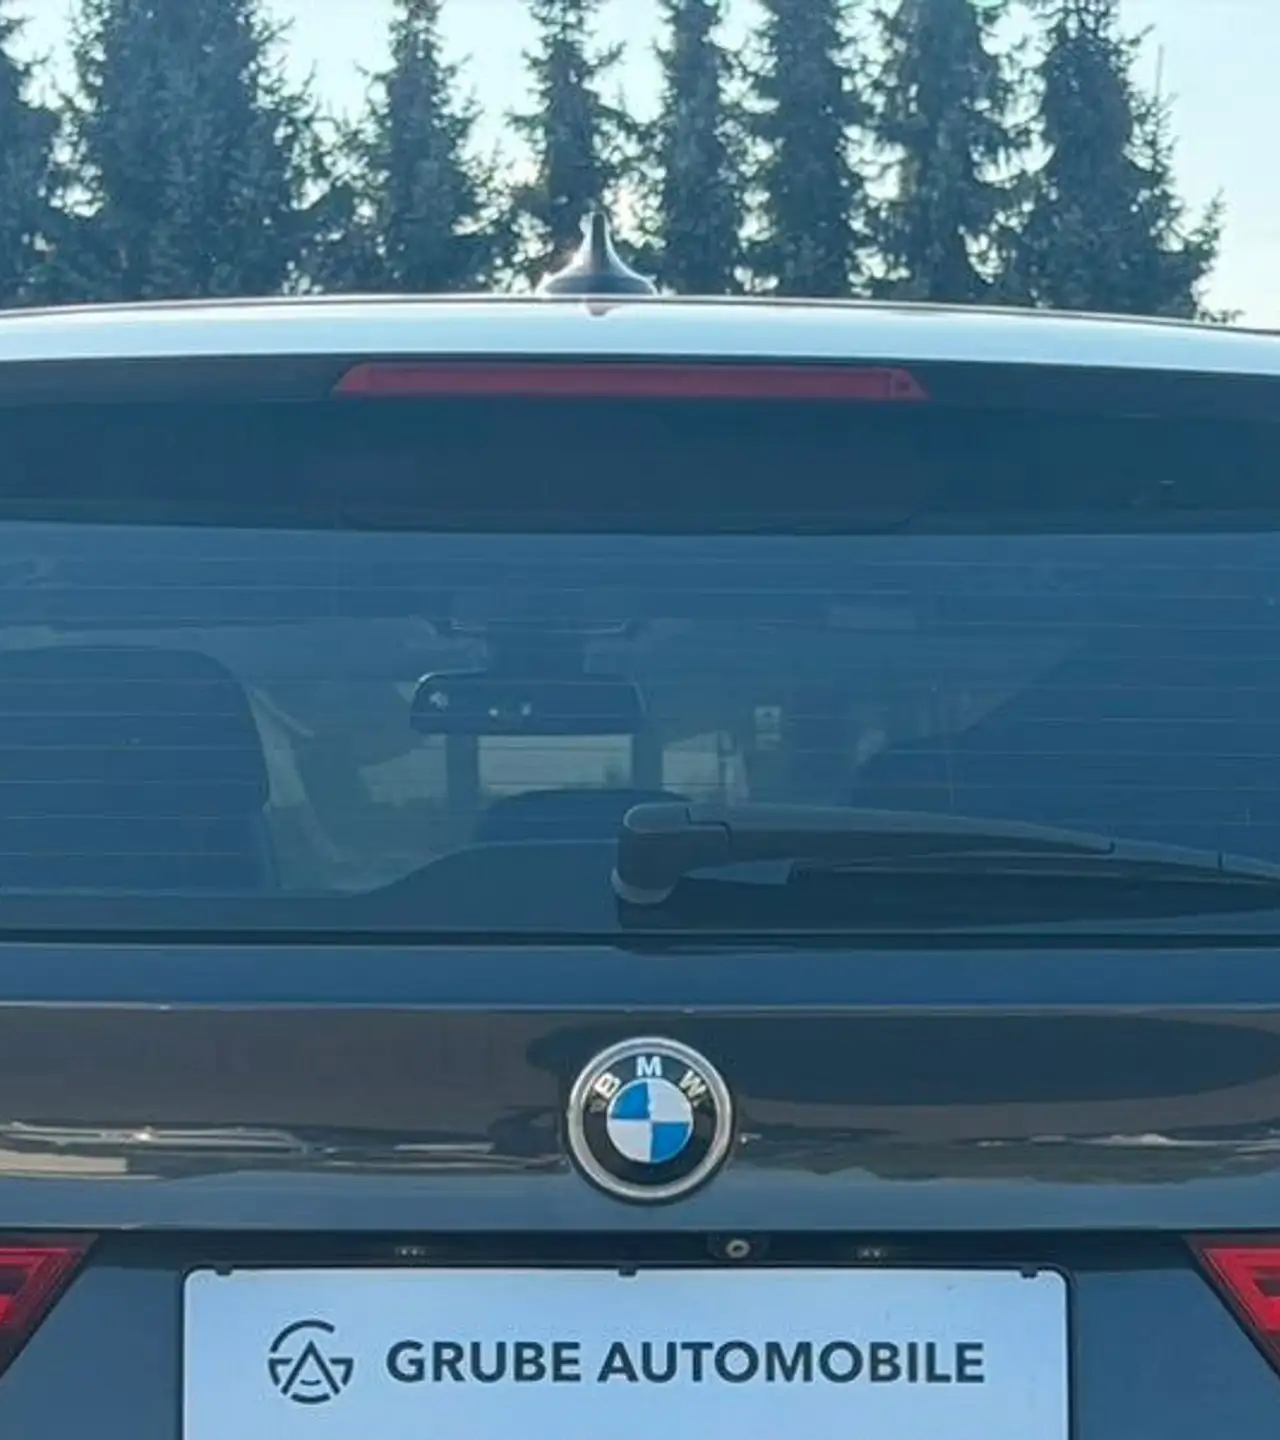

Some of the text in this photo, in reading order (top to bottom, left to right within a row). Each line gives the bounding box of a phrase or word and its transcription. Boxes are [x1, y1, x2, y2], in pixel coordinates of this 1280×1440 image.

[594, 1056, 707, 1107] BMW
[386, 1340, 985, 1383] GRUBE AUTOMOBILE
